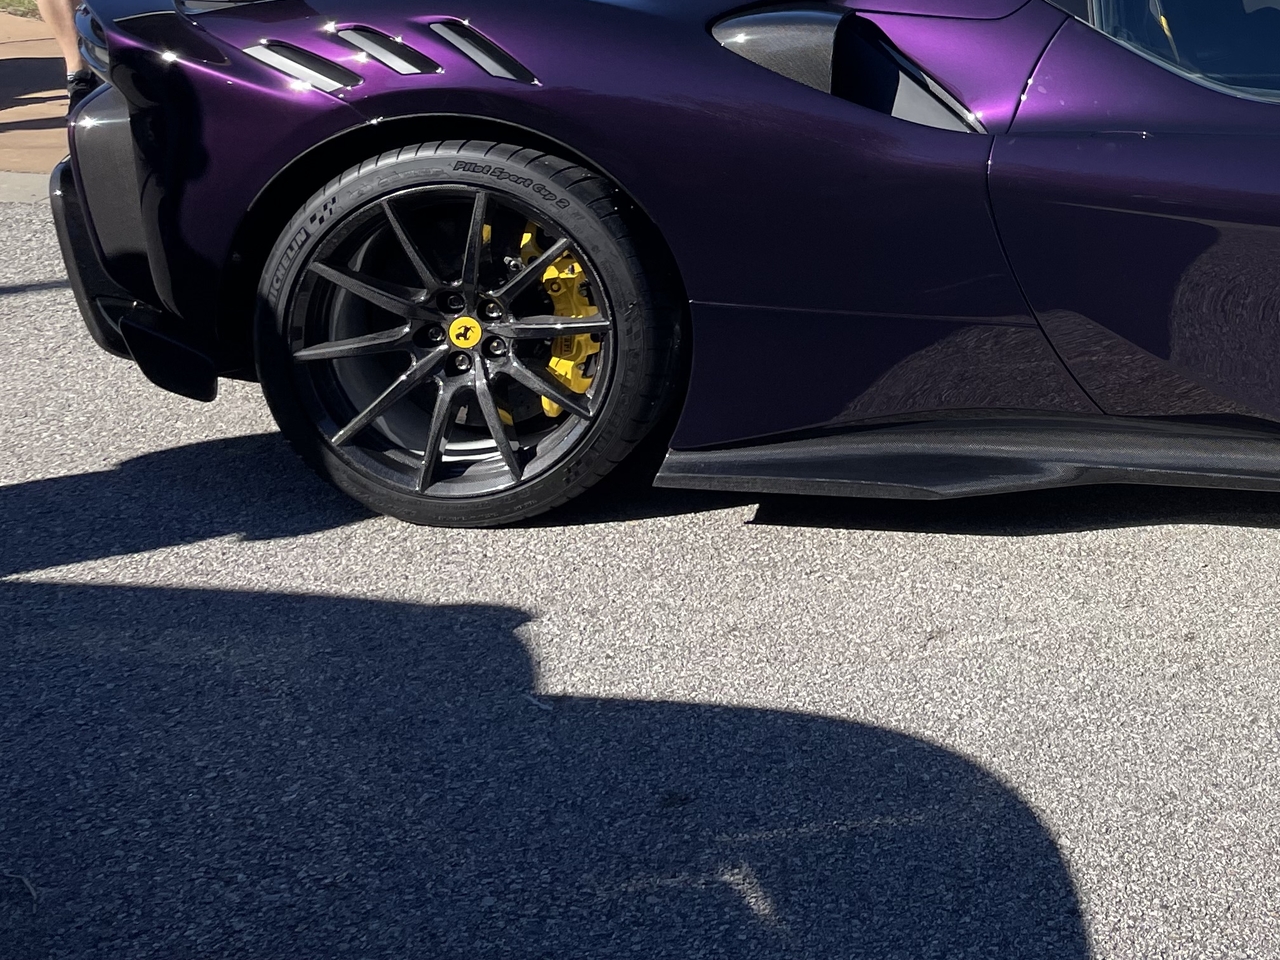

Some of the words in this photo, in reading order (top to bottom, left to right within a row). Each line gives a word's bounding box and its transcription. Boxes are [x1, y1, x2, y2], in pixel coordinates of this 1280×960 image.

[453, 161, 492, 175] Pilot
[490, 166, 534, 188] Sport
[532, 183, 558, 201] Cup
[556, 198, 571, 209] 2
